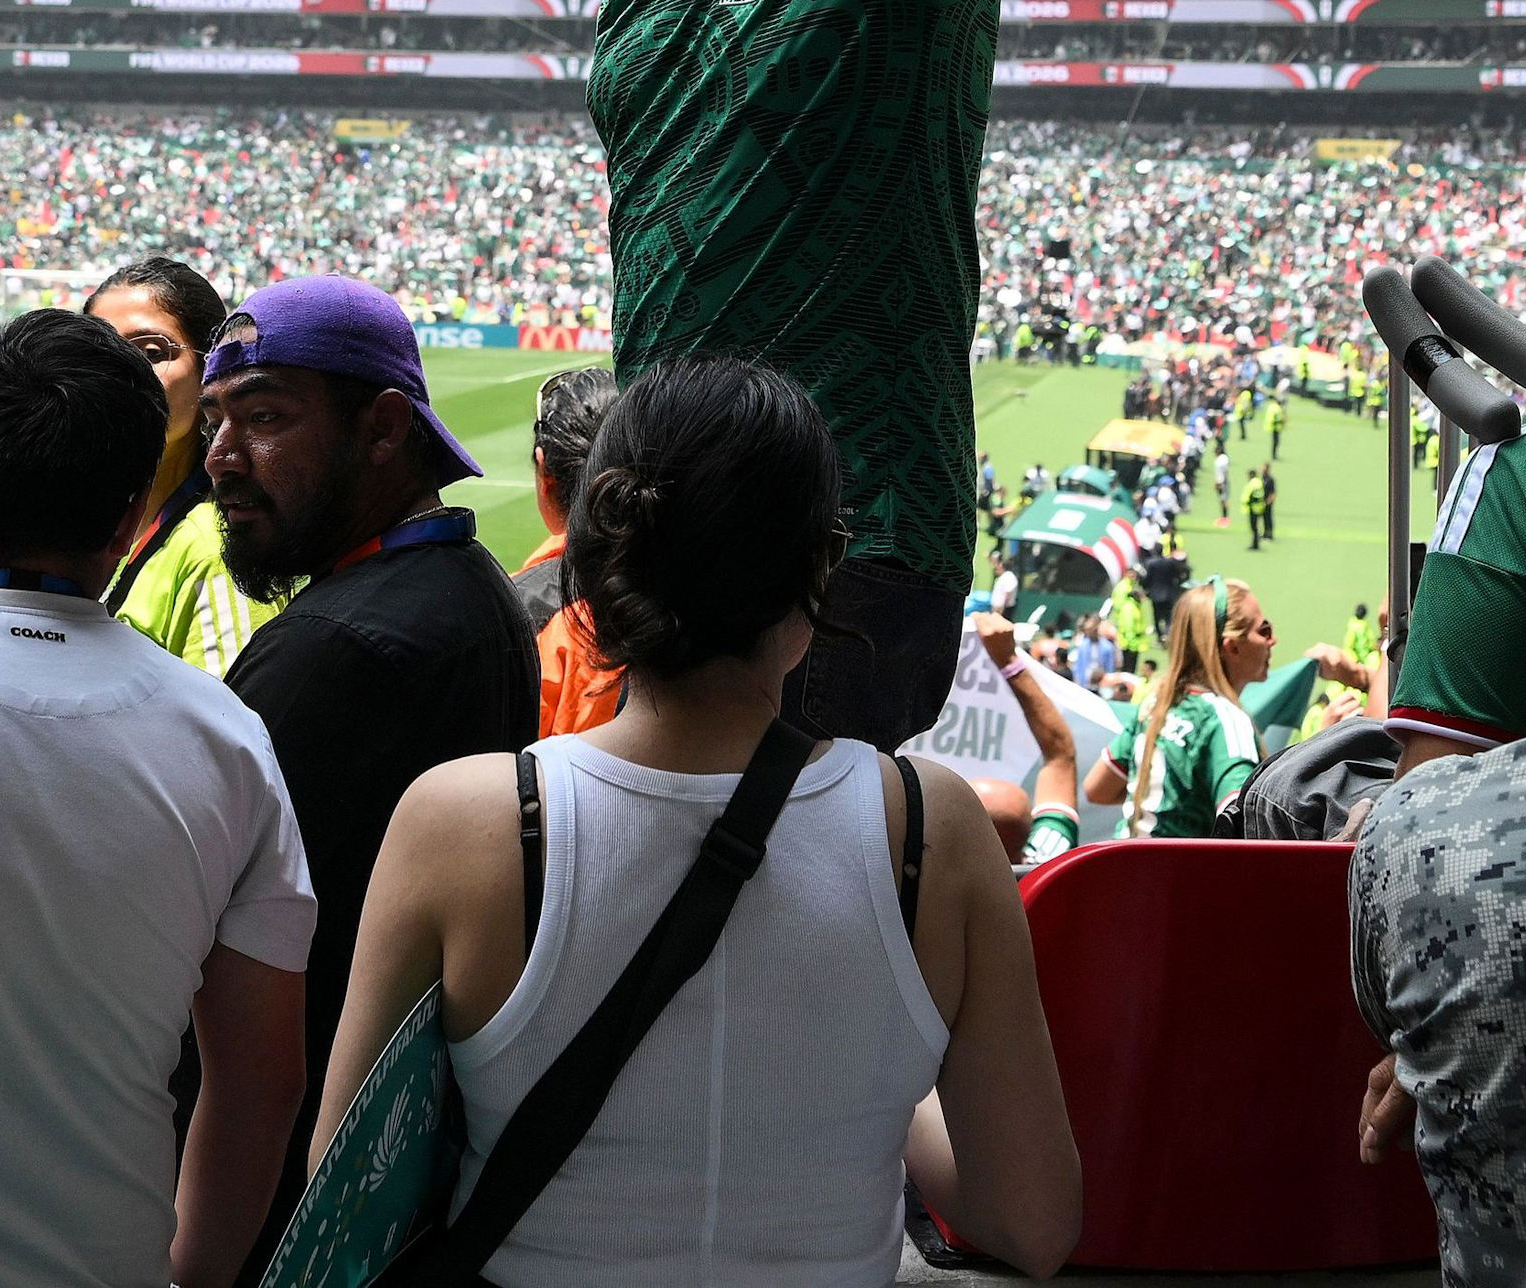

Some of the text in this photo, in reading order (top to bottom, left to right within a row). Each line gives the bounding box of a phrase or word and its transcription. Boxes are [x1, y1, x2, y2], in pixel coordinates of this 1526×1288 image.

[1016, 1, 1069, 18] 2026
[1015, 66, 1069, 82] 2026
[419, 326, 484, 349] nse
[10, 626, 66, 643] COACH
